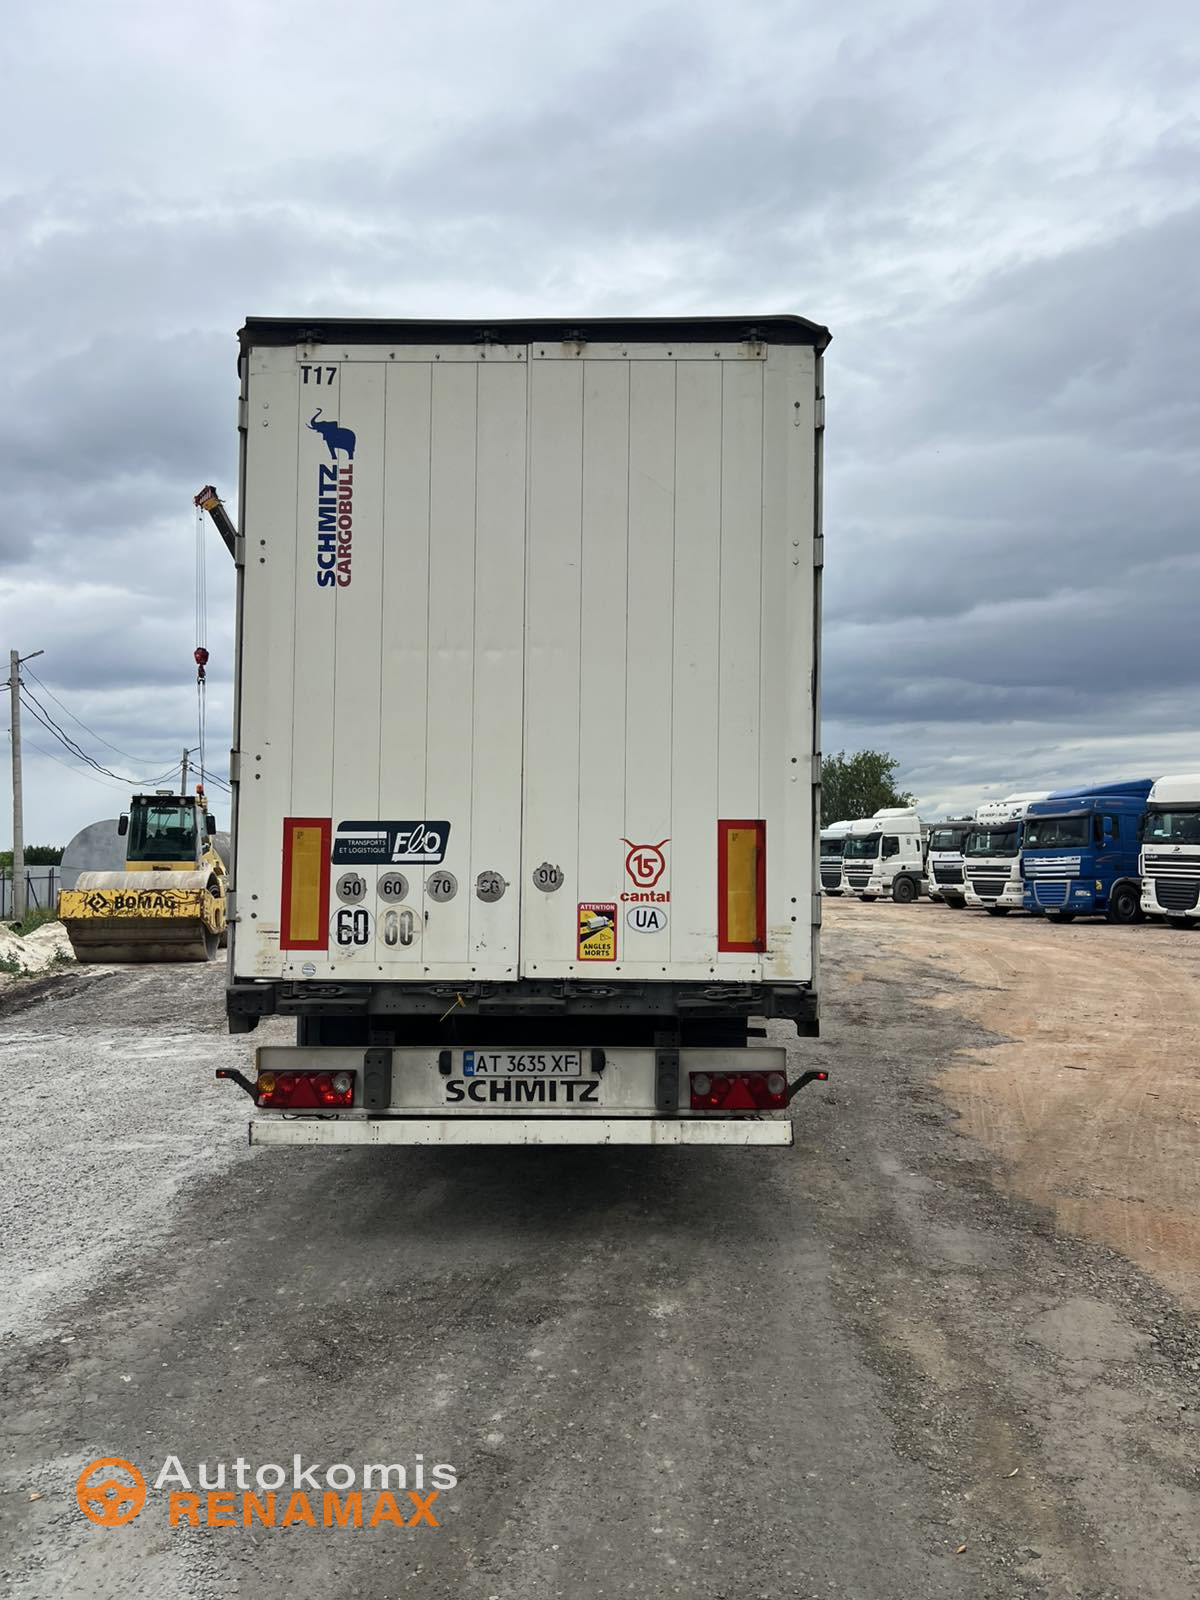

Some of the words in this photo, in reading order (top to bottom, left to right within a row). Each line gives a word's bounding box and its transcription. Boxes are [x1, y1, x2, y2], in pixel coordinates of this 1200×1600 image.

[301, 365, 337, 385] T17
[317, 464, 337, 587] SCHMITZ
[337, 464, 353, 588] CARGOBULL
[633, 853, 658, 877] 15
[539, 869, 557, 883] 90
[343, 881, 361, 896] 50
[383, 880, 402, 895] 60
[433, 879, 451, 894] 70
[114, 895, 176, 909] BOMAG
[620, 891, 671, 902] cantal
[337, 910, 369, 945] 60
[636, 910, 659, 928] UA
[475, 1055, 501, 1072] AT
[507, 1055, 546, 1072] 3635
[551, 1055, 576, 1072] XF
[446, 1079, 599, 1102] SCHMITZ
